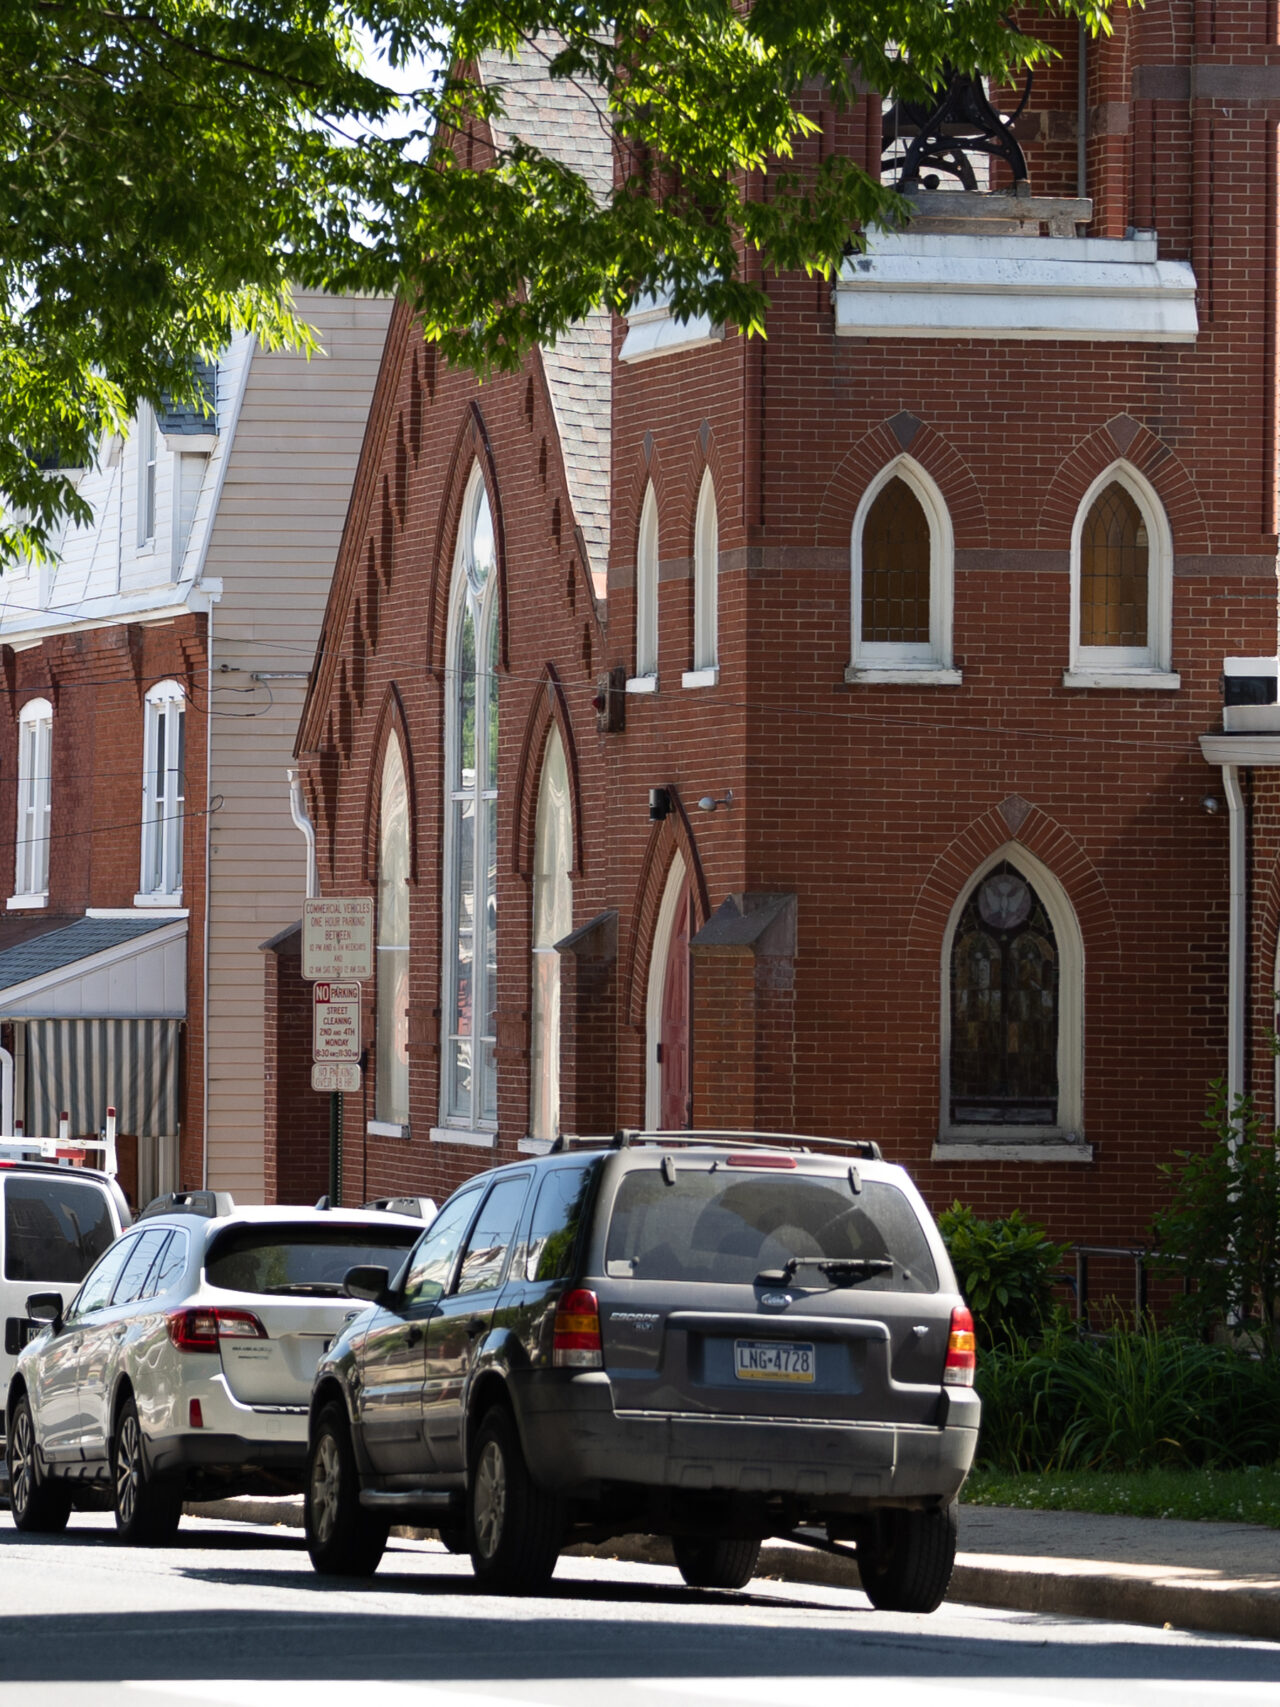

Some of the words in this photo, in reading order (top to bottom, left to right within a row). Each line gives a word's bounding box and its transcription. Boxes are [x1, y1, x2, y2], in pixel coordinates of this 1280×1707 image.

[306, 903, 341, 914] COMMERCIAL
[344, 903, 370, 914] VEHICLES
[311, 916, 322, 927] ONE
[325, 916, 340, 927] HOUR
[342, 916, 365, 927] PARKING
[325, 930, 351, 940] BETWEEN
[316, 985, 329, 1001] NO
[331, 988, 357, 998] PARKING
[327, 1006, 348, 1014] STREET
[323, 1017, 352, 1025] CLEANING
[320, 1028, 332, 1036] 2ND
[343, 1028, 355, 1036] 4TH
[315, 1049, 329, 1057] 8:30
[609, 1312, 660, 1321] ESCAPE
